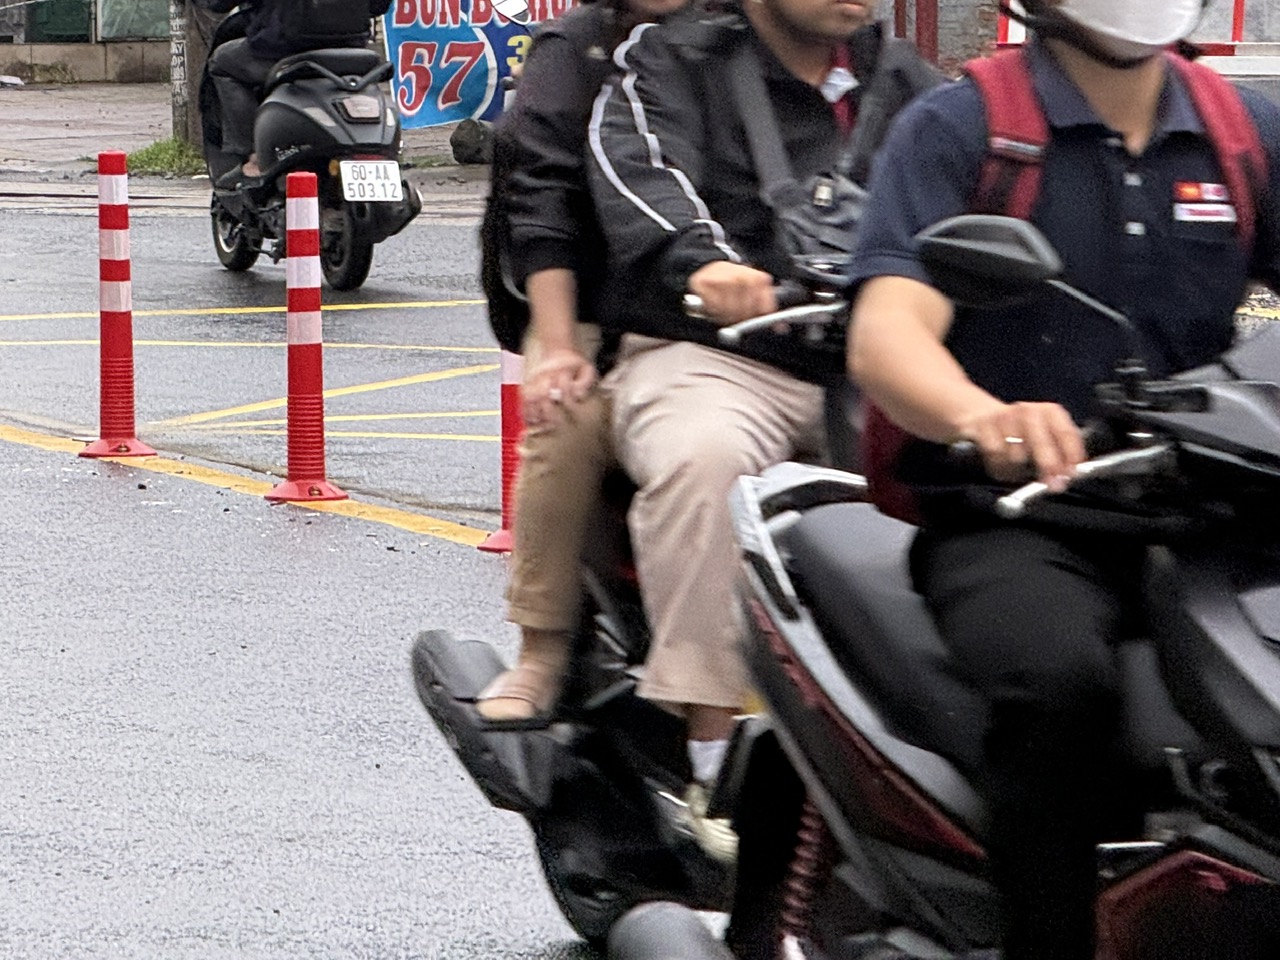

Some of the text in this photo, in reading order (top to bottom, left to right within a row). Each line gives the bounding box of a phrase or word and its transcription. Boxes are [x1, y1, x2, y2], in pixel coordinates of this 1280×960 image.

[398, 41, 486, 117] 57
[351, 164, 390, 181] 60-AA
[347, 182, 399, 199] 503.12
